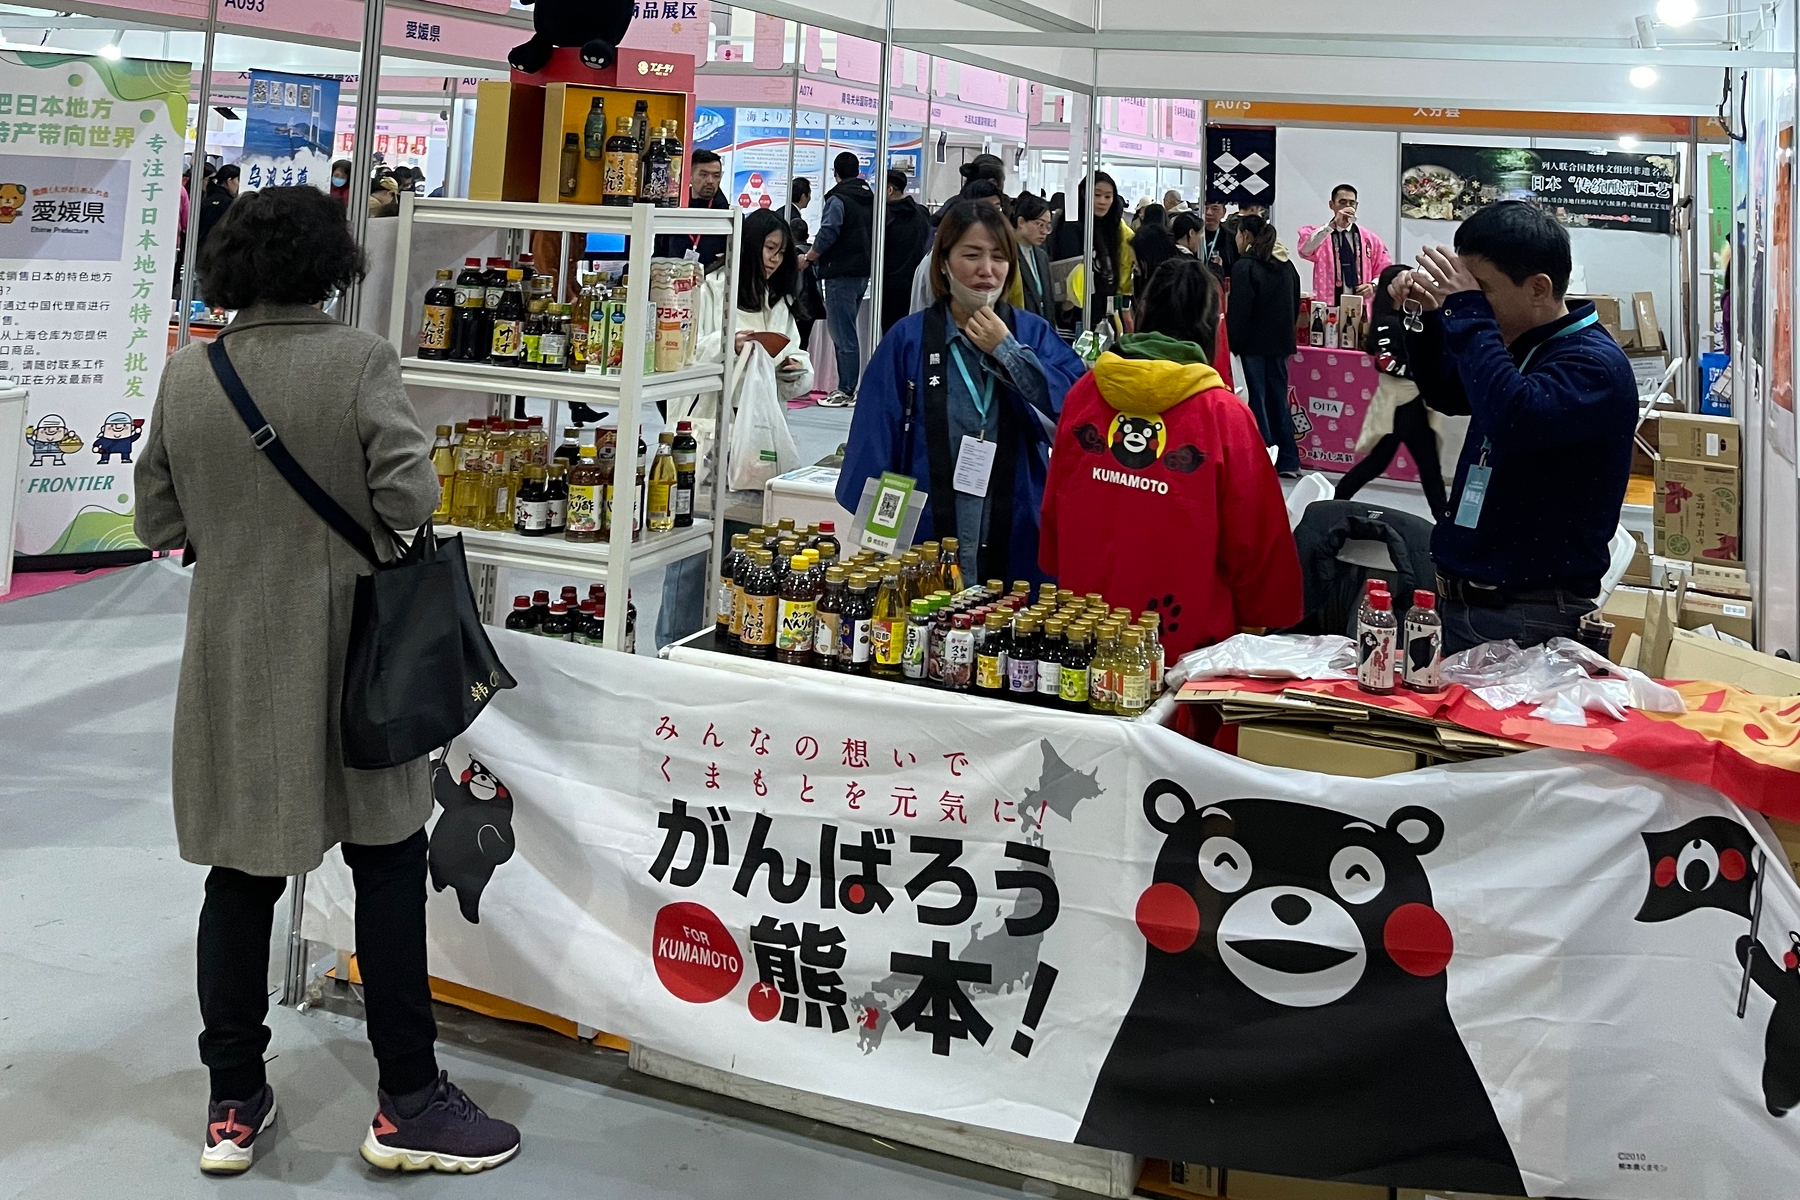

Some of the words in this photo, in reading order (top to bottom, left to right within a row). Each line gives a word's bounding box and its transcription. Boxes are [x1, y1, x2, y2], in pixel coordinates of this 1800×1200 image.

[406, 20, 441, 43] 愛媛県
[604, 166, 616, 192] たれ
[31, 200, 105, 223] 愛媛県
[122, 133, 168, 398] 专注于日本地方特产批发
[0, 300, 111, 311] 通过中国代理商进行
[0, 315, 19, 326] 售。
[0, 330, 108, 341] 从上海仓库为您提供
[1312, 401, 1338, 413] OITA
[27, 475, 115, 494] FRONTIER
[1092, 467, 1169, 495] KUMAMOTO
[742, 611, 756, 641] たれ
[655, 714, 970, 777] みんなの想いで
[660, 754, 1048, 830] くまもとを元気に!
[648, 797, 1061, 937] がんばろう
[682, 924, 711, 947] FOR
[657, 936, 739, 974] KUMAMOTO
